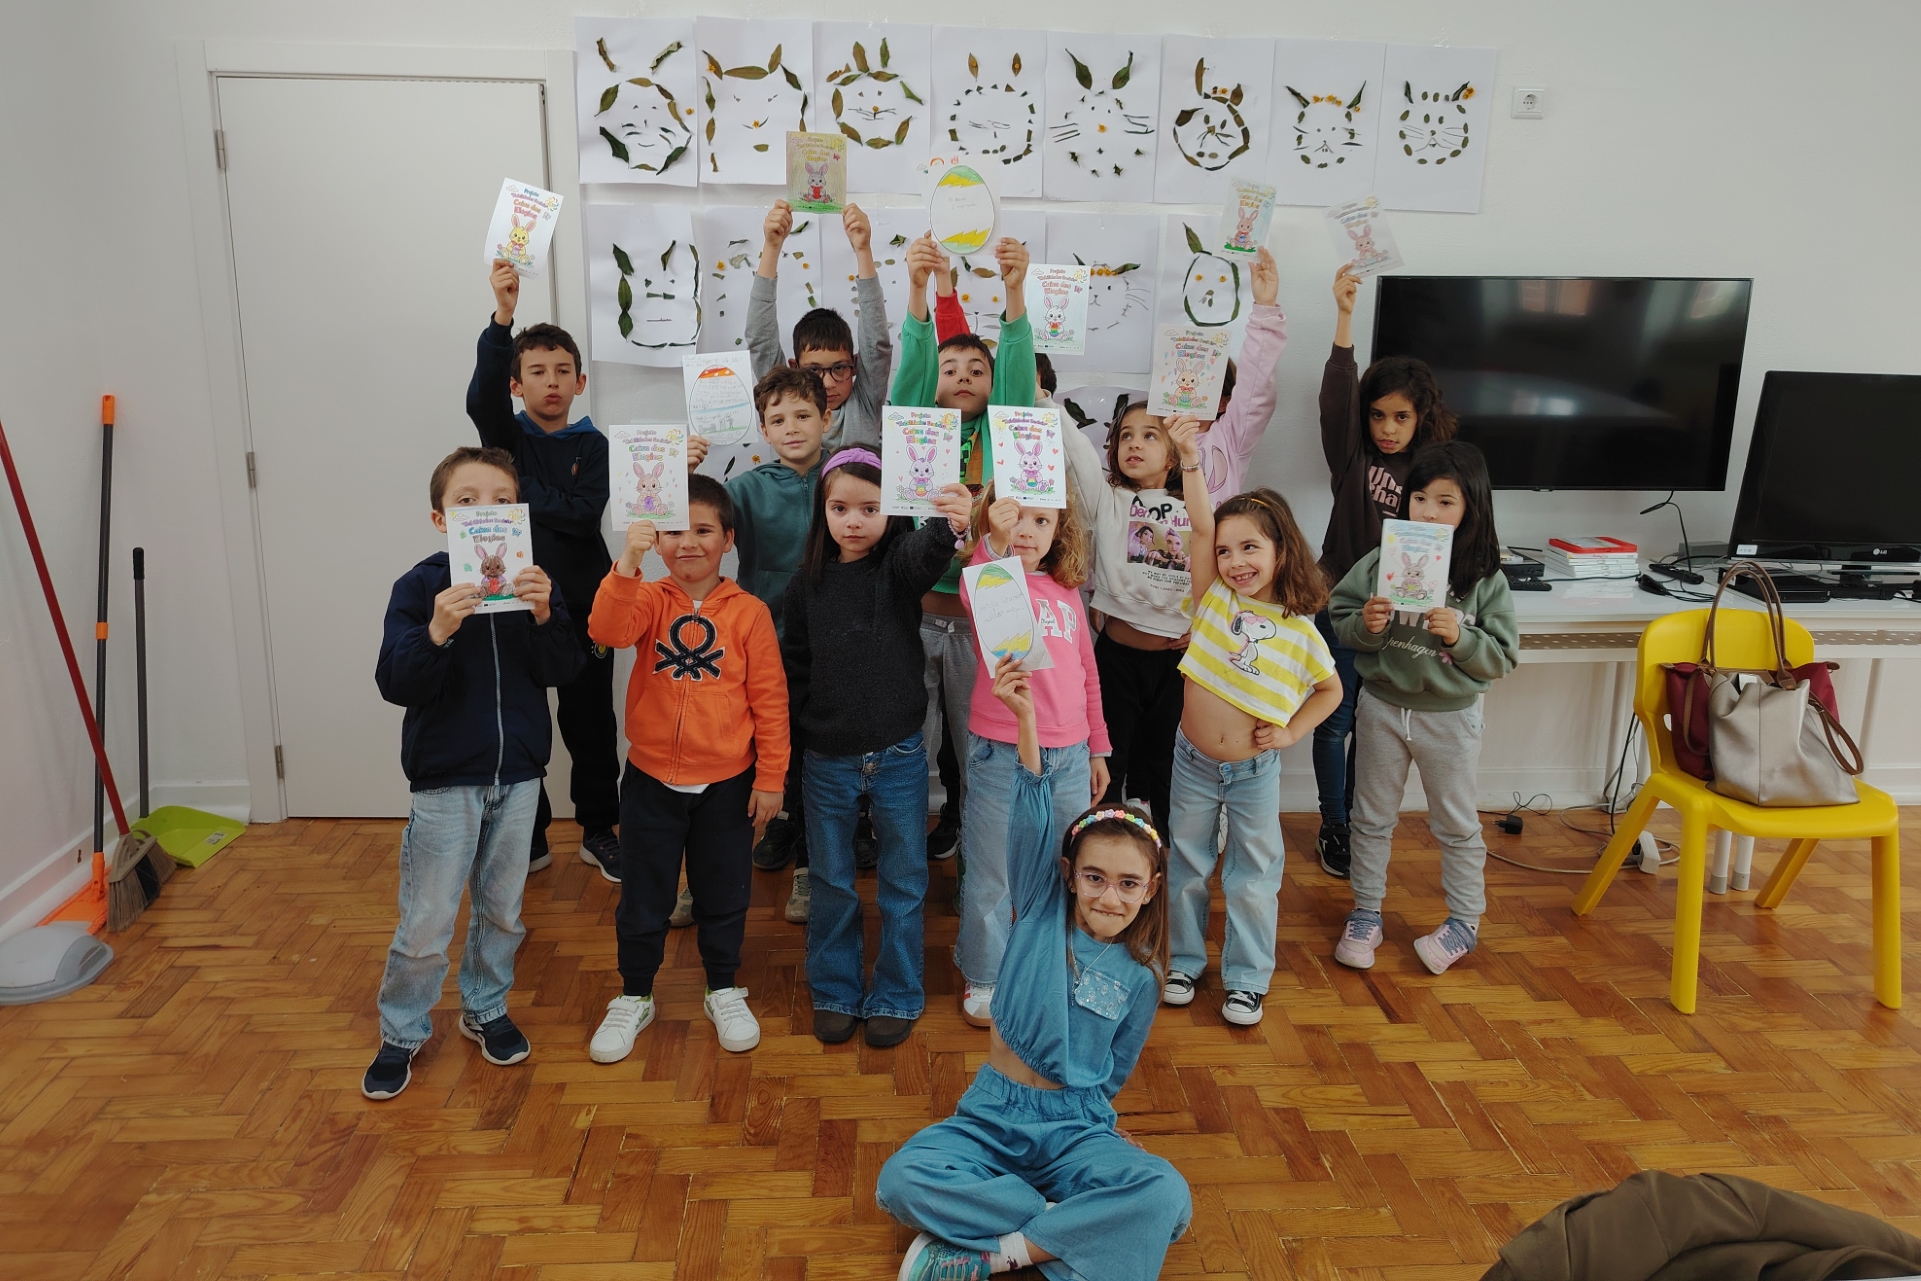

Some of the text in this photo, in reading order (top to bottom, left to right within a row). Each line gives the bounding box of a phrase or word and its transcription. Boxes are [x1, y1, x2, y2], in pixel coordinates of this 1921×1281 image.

[514, 206, 538, 220] Elogios
[911, 411, 931, 419] Projeto
[1014, 410, 1033, 418] Projeto
[925, 428, 940, 437] dos
[1029, 425, 1042, 433] dos
[906, 435, 936, 445] Elogios
[1013, 431, 1041, 440] Elogios
[651, 444, 665, 452] dos
[632, 452, 663, 462] Elogios
[468, 525, 508, 535] Caixa dos
[472, 534, 505, 543] Elogios
[1035, 598, 1076, 644] AP
[1382, 636, 1437, 659] penhagen
